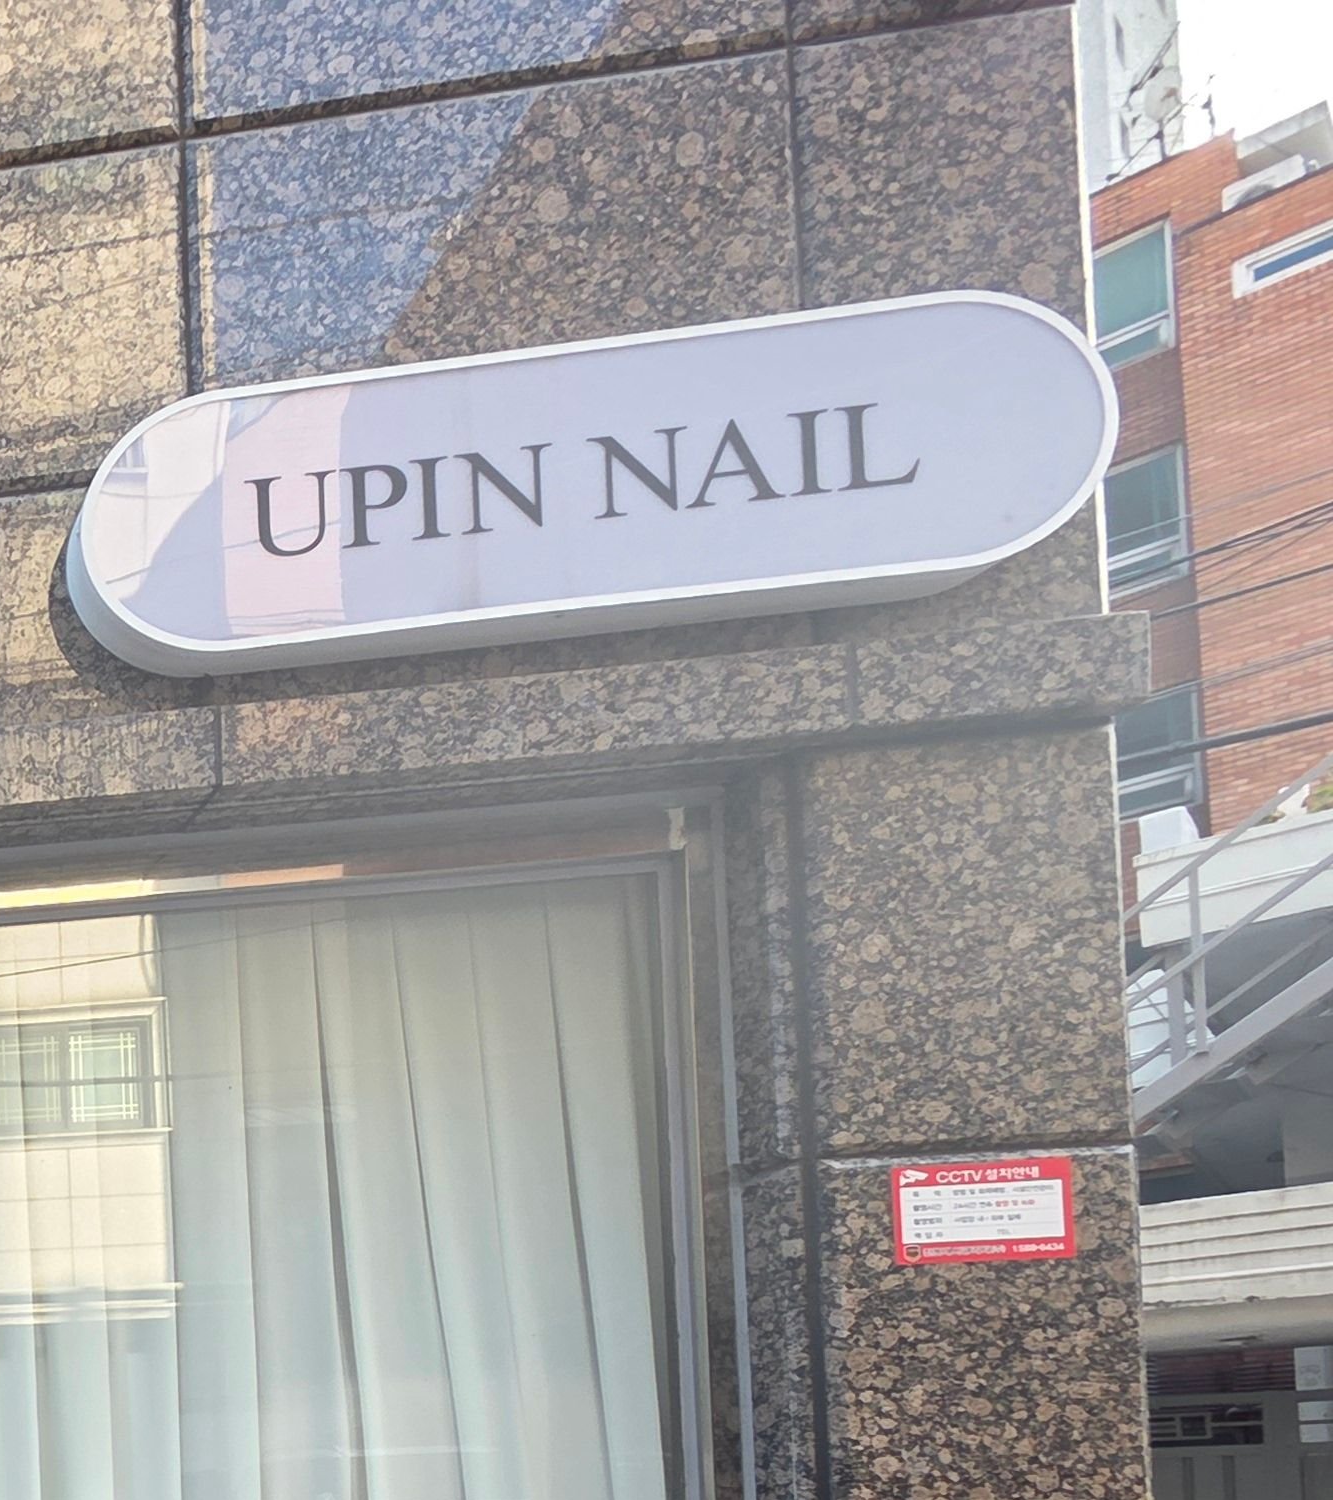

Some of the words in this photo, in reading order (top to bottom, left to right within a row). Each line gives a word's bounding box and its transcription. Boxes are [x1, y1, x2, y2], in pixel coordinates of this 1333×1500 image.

[245, 440, 552, 558] UPIN
[587, 403, 920, 521] NAIL
[935, 1169, 983, 1183] CCTV
